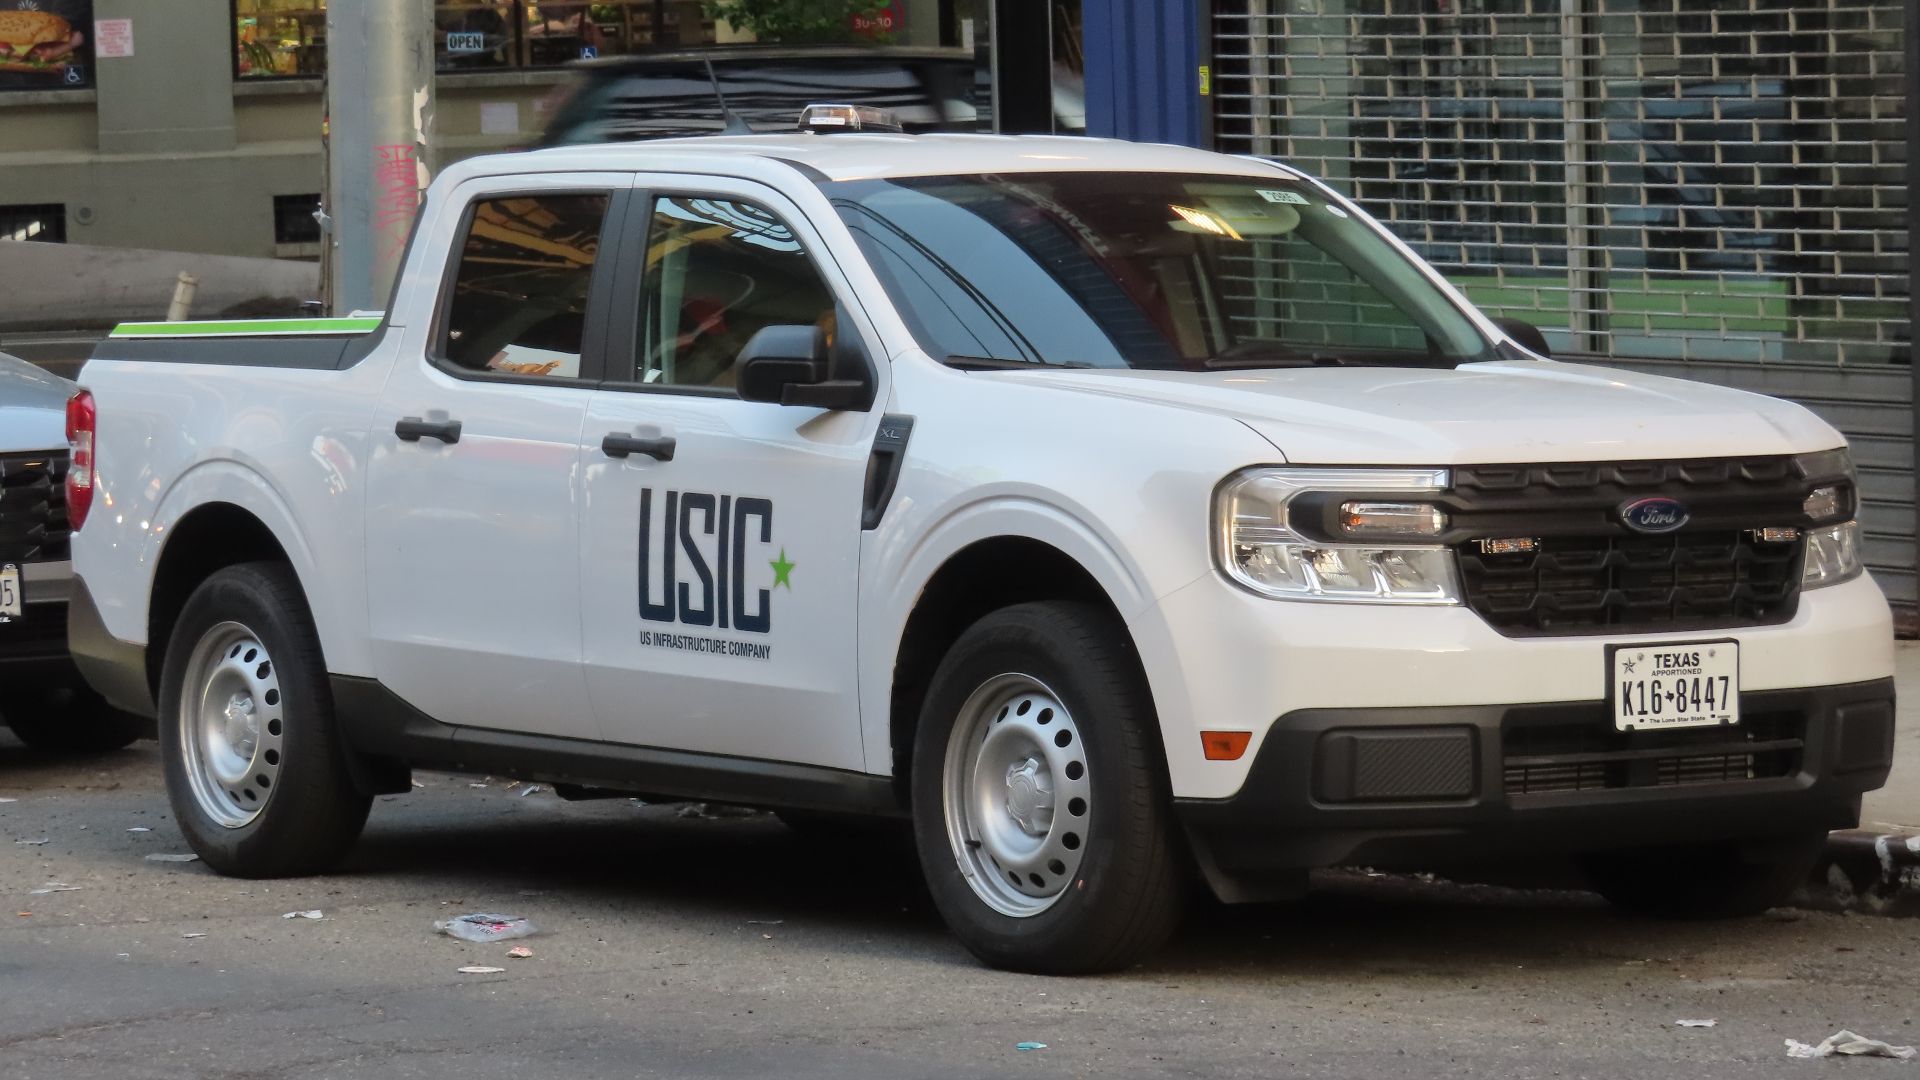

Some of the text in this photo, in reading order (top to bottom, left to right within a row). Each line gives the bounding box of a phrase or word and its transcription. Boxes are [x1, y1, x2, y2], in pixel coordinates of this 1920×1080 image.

[450, 35, 482, 48] OPEN
[880, 428, 900, 439] XL
[1641, 505, 1676, 525] Ford
[638, 487, 773, 633] USIC
[640, 630, 771, 660] US INFRASTRUCTURE COMPANY
[1654, 652, 1700, 668] TEXAS
[1651, 668, 1702, 677] APPORTIONED
